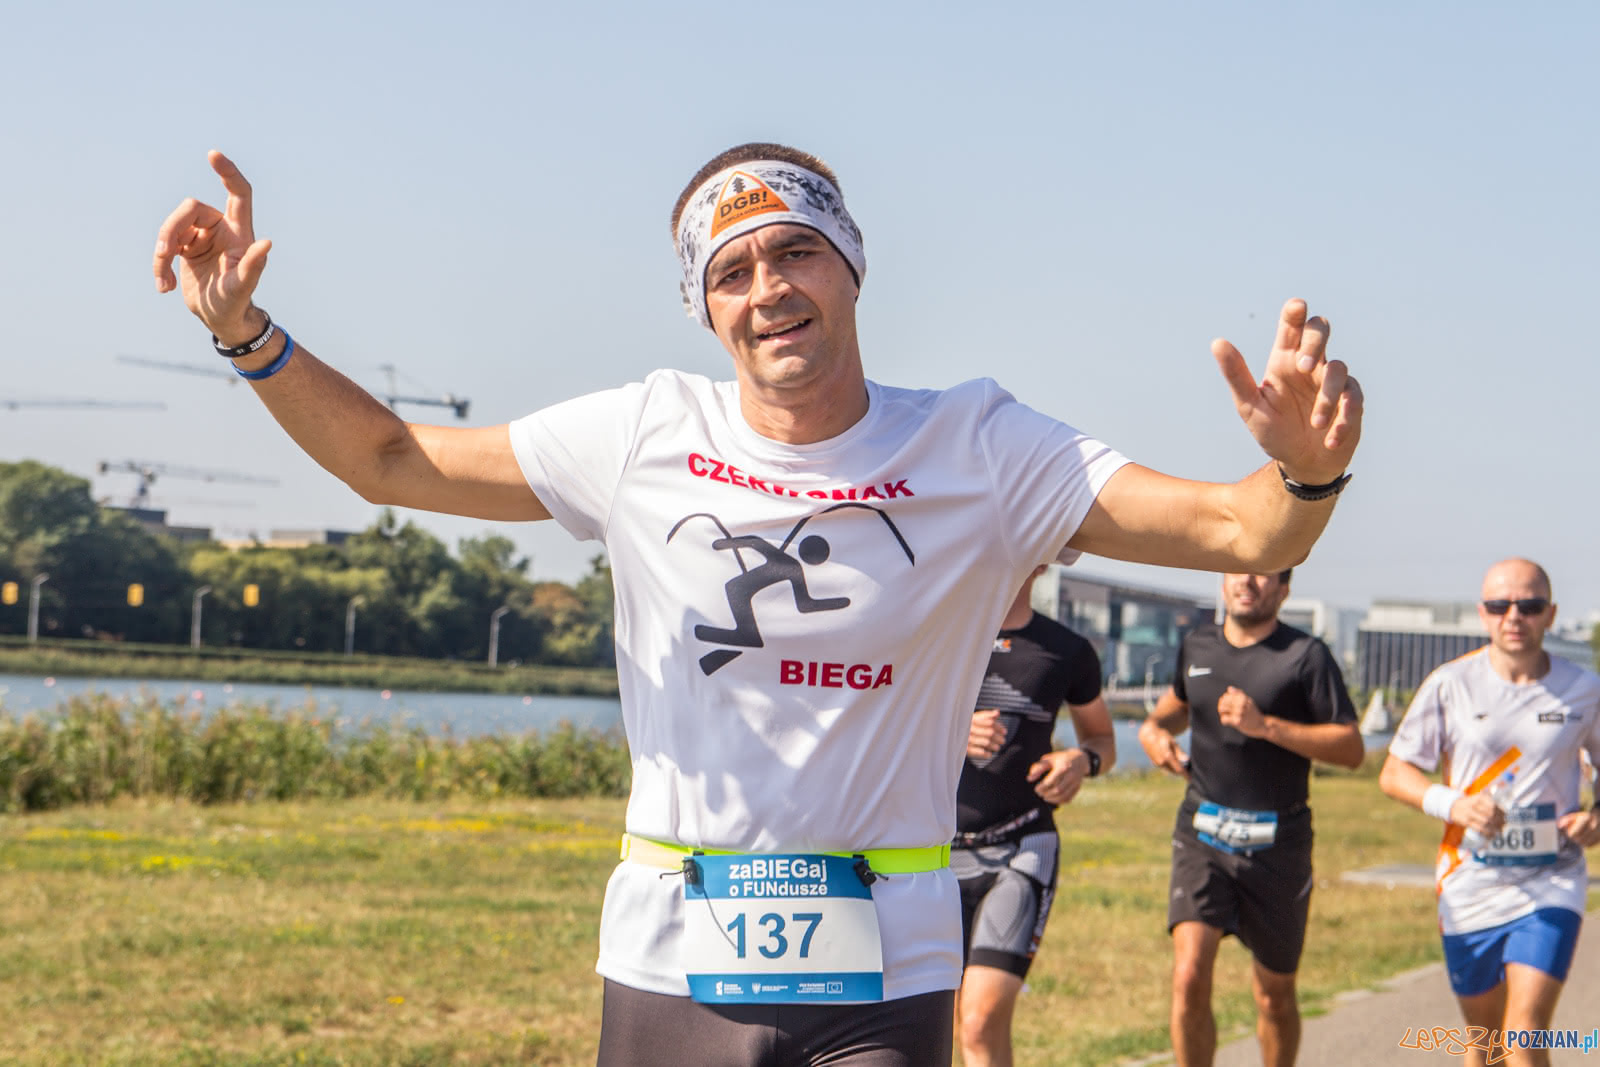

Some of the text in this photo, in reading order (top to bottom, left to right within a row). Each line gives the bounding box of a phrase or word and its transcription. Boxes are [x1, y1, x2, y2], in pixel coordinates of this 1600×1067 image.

[720, 190, 768, 219] DGB!
[779, 659, 893, 690] BIEGA
[729, 859, 828, 881] zaBIEGaj
[729, 881, 828, 896] o FUNdusze
[727, 912, 823, 959] 137
